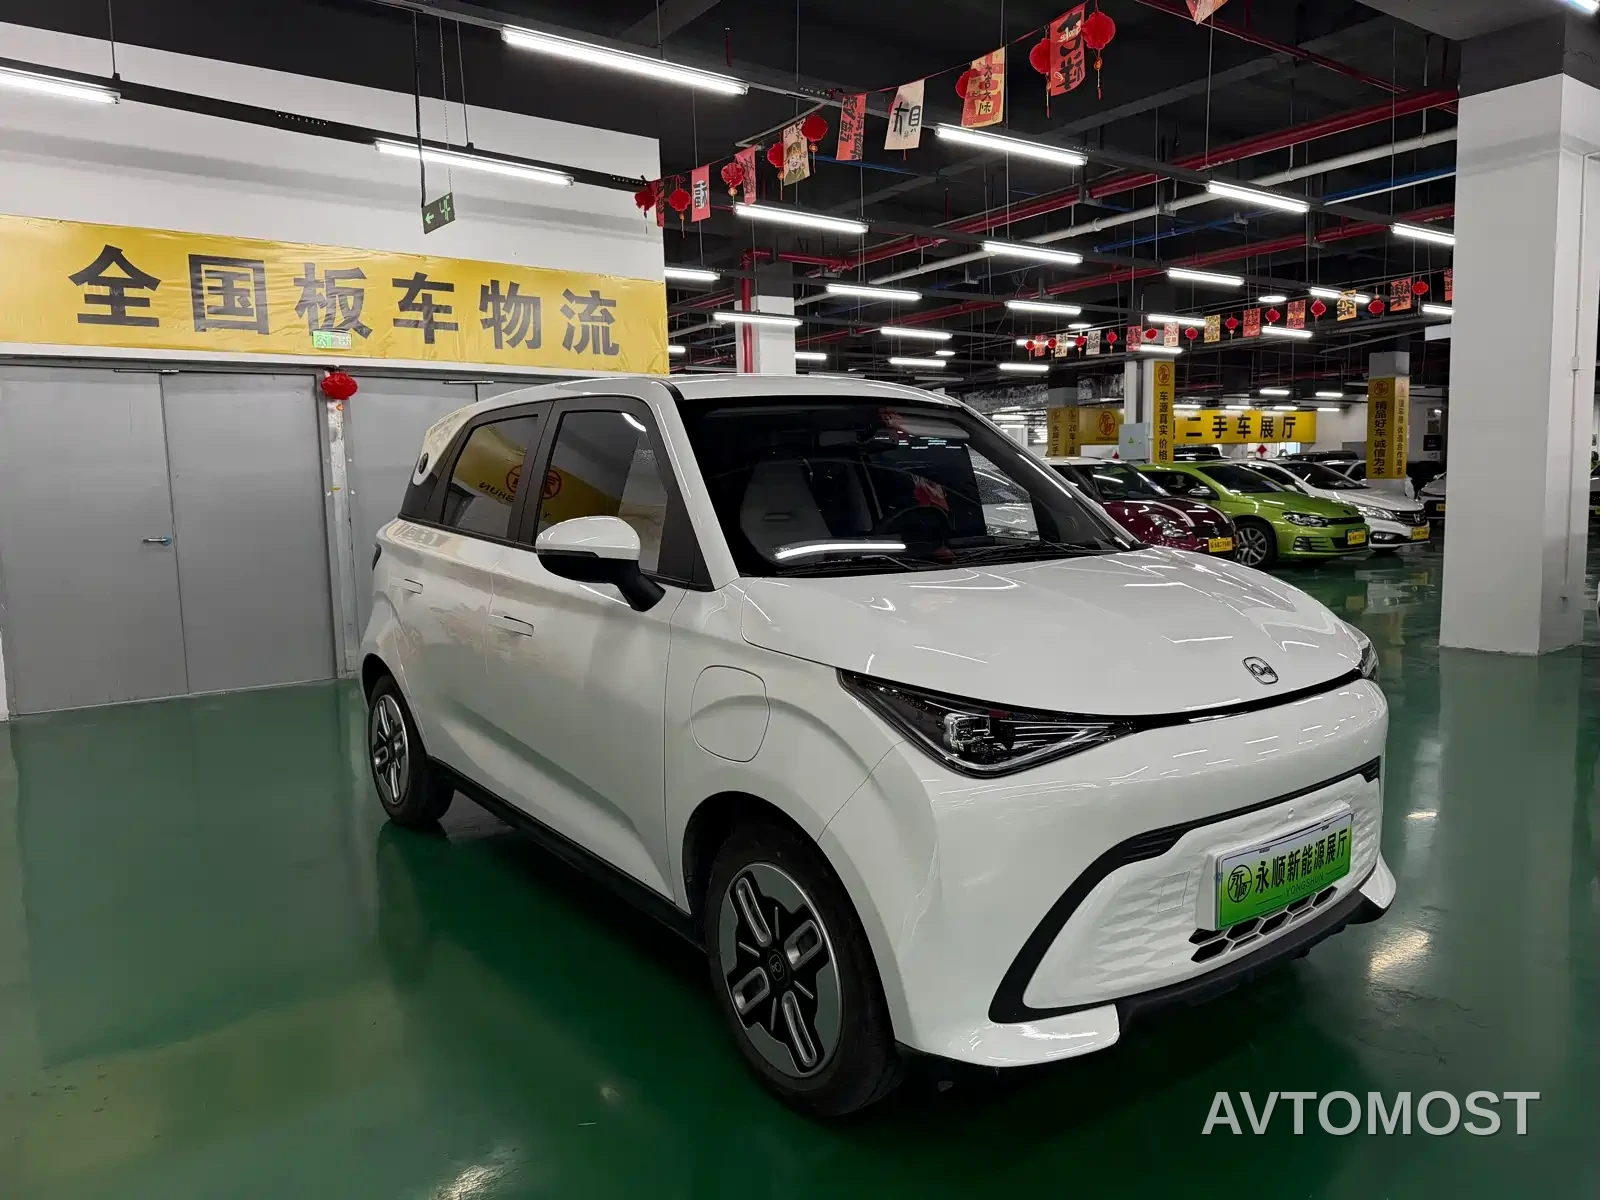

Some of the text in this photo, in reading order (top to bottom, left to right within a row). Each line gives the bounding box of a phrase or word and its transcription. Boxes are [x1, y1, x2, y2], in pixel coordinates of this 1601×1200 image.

[68, 243, 621, 356] 全国板车物流
[1158, 391, 1168, 435] 车源真实
[1173, 415, 1296, 439] 二手车展厅
[1373, 439, 1386, 475] 诚信为本
[1255, 828, 1348, 894] 永顺新能源展厅
[1286, 871, 1324, 897] YONGSHUN
